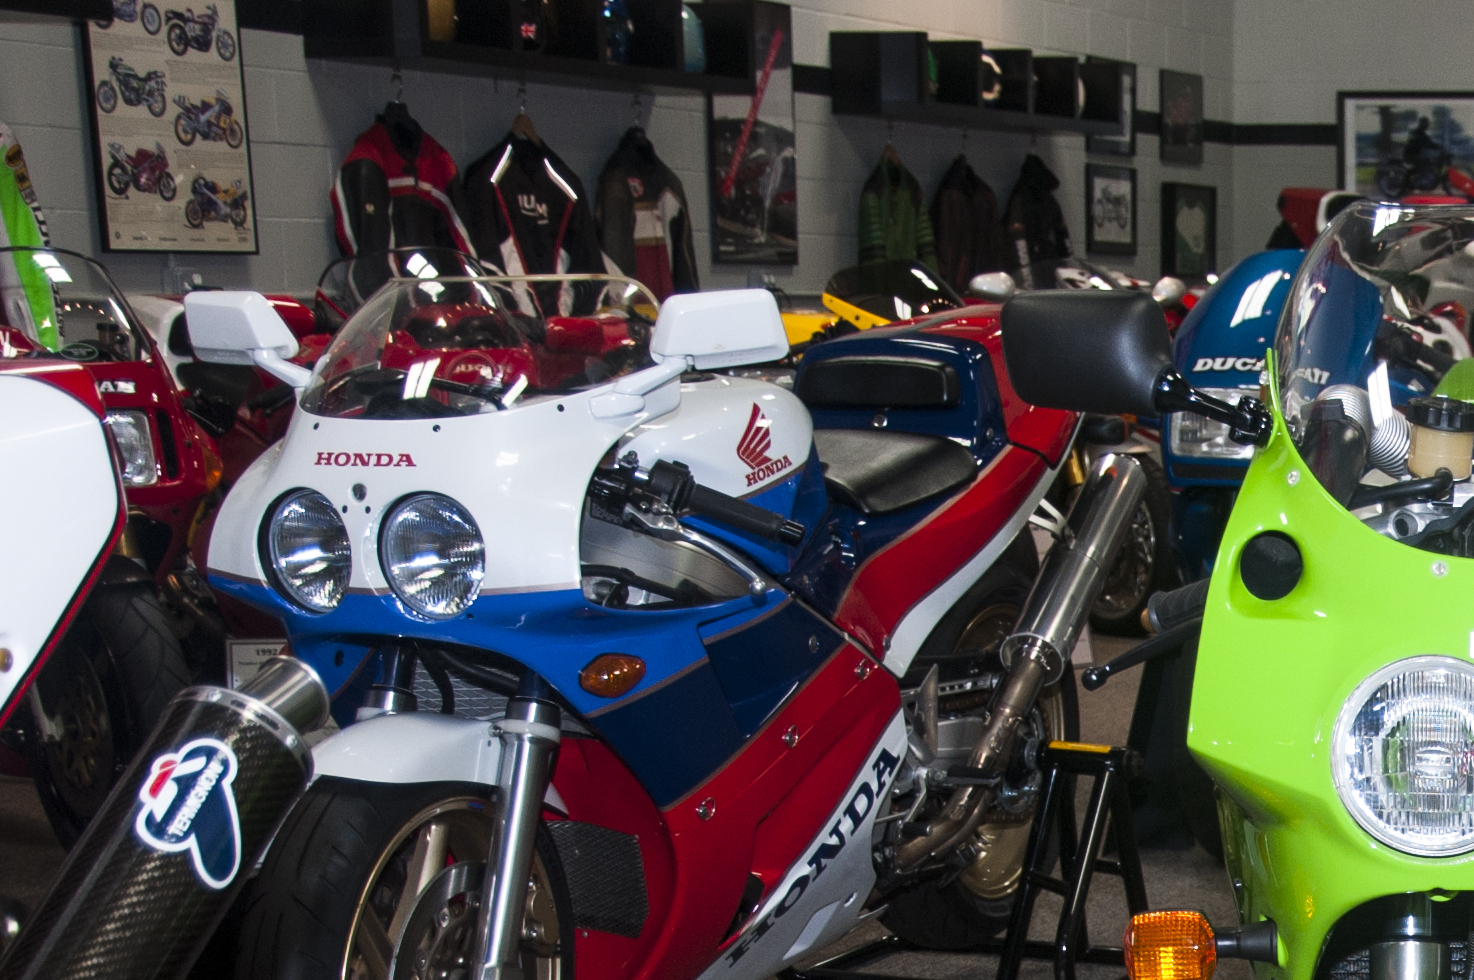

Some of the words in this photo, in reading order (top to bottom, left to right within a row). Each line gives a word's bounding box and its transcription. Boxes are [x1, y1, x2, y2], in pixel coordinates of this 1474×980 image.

[314, 452, 417, 467] HONDA
[745, 454, 793, 487] HONDA
[167, 756, 225, 838] TERMIGNONI
[725, 747, 900, 968] HONDA
